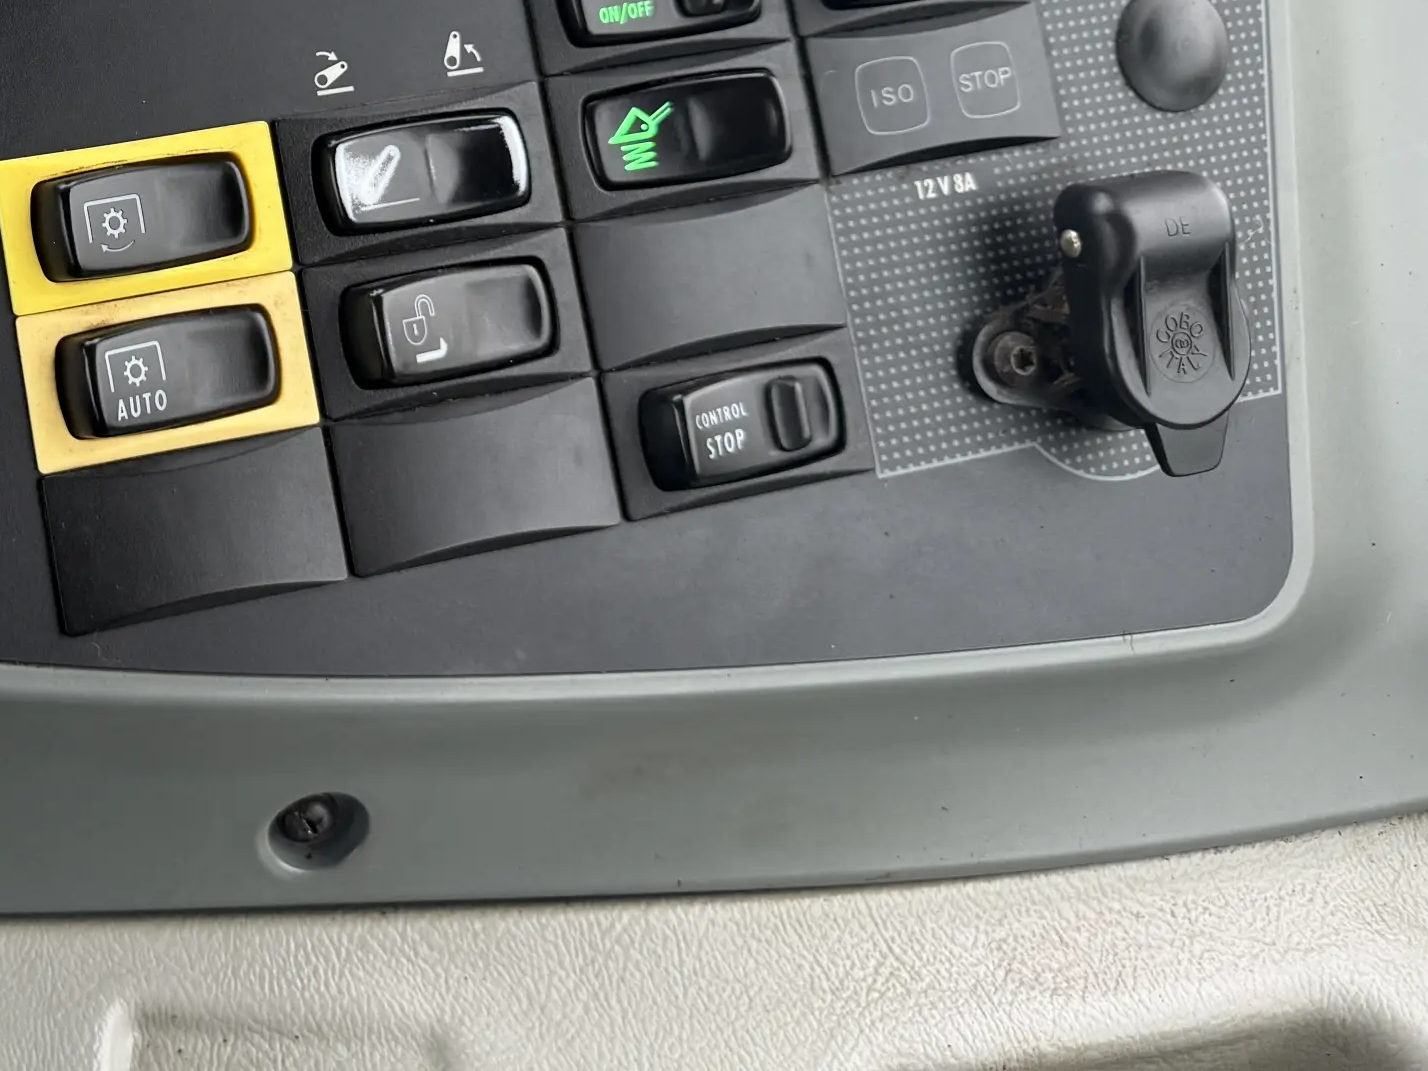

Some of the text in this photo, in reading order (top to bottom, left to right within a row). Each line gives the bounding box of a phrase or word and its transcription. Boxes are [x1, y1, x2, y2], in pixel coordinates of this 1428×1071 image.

[599, 0, 655, 25] ON/OFF
[959, 65, 1012, 93] STOP
[870, 83, 914, 108] ISO
[953, 172, 976, 195] 8A
[1164, 217, 1192, 237] DE
[1156, 311, 1203, 343] COBO
[117, 393, 167, 421] AUTO
[695, 401, 748, 430] CONTROL
[706, 428, 745, 459] STOP
